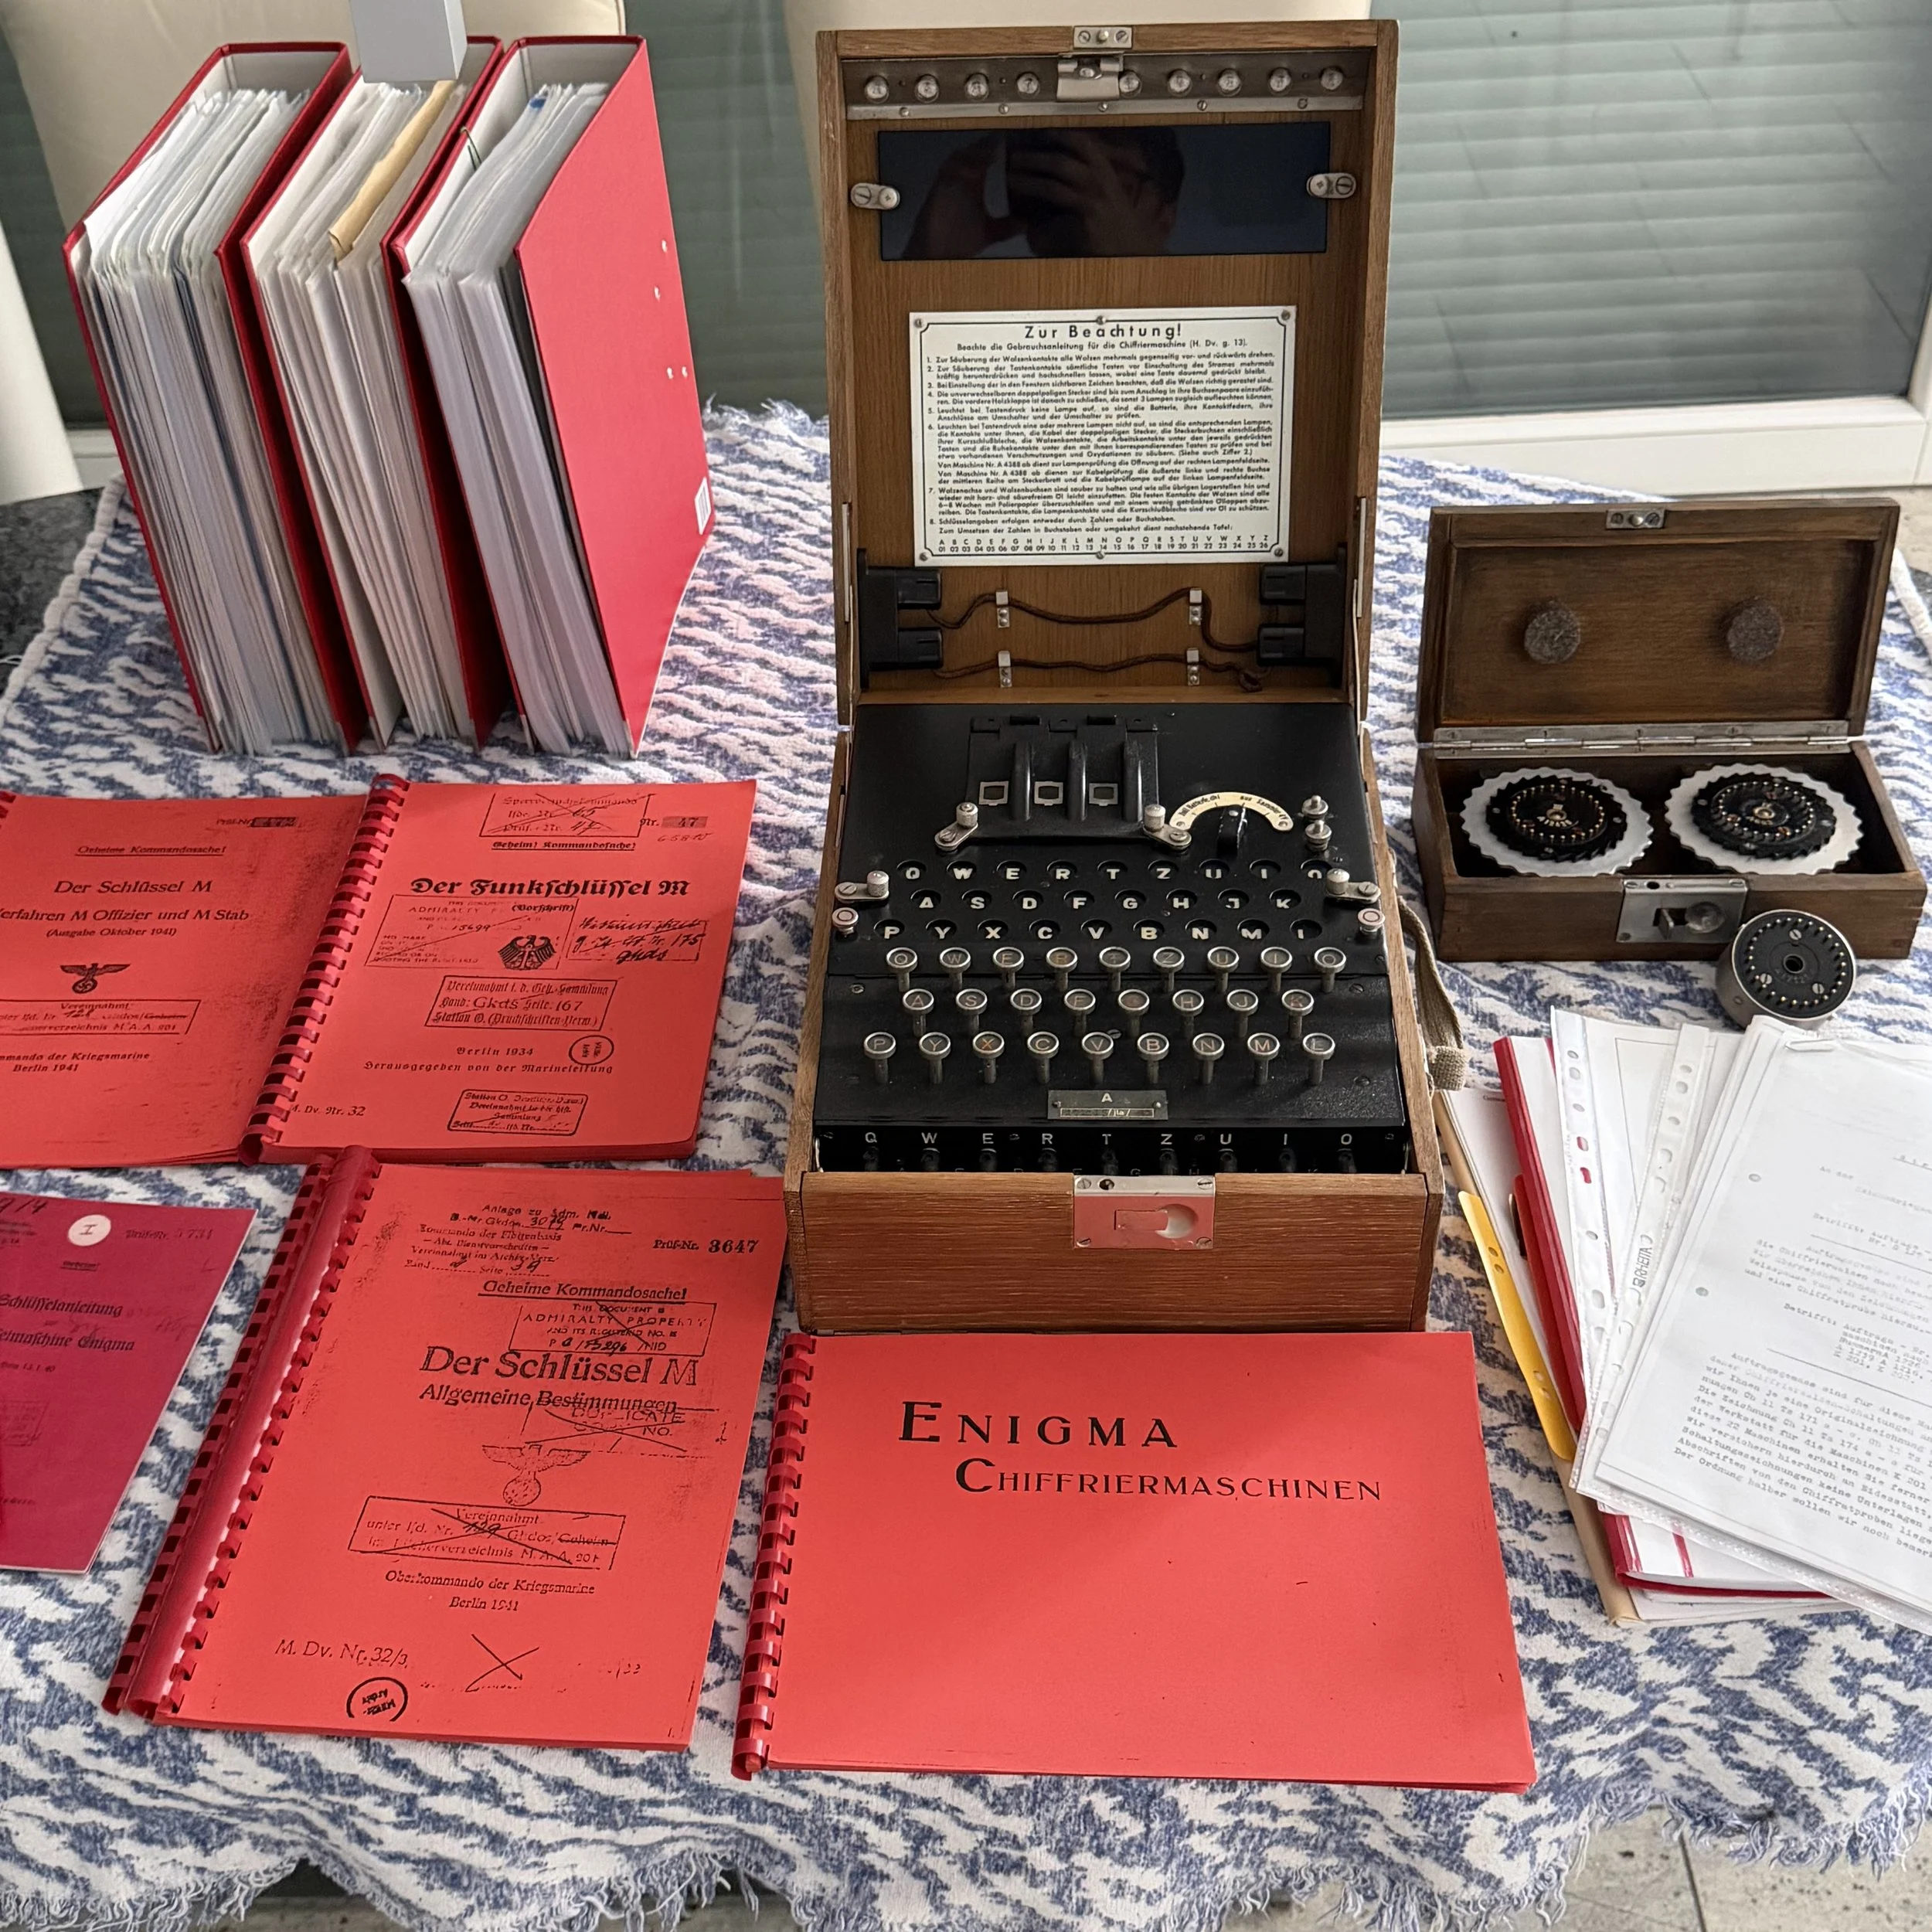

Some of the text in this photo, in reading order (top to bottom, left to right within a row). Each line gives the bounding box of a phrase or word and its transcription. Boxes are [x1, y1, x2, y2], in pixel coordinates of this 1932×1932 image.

[1025, 323, 1181, 340] Zur Beachtung!
[991, 342, 1003, 351] die
[1007, 342, 1083, 352] Gebrauchsanleitung
[1088, 341, 1100, 350] für
[1103, 341, 1115, 349] die
[1120, 340, 1185, 349] Chiffriermaschine
[939, 517, 998, 526] Schlüsselangaben
[1002, 517, 1029, 526] erfolgen
[1090, 515, 1114, 524] Zahlen
[1085, 524, 1100, 532] oder
[1104, 525, 1141, 533] umgekehrt
[1164, 523, 1210, 532] nachstehende
[906, 868, 1267, 879] Q W E R T Z U I
[54, 880, 213, 893] Der Schlüssel M
[410, 877, 463, 894] Der
[658, 880, 690, 896] M
[920, 897, 1290, 909] A S D F G H J K
[70, 910, 88, 920] M
[93, 910, 152, 920] Offizier
[157, 910, 189, 920] und
[193, 910, 210, 920] M
[214, 910, 250, 920] Stab
[100, 927, 147, 936] Oktober
[885, 927, 1261, 940] P Y X C V B N M
[556, 1001, 583, 1011] 167
[71, 1052, 151, 1062] Kriegsmarine
[457, 1047, 499, 1056] Berlin
[363, 1061, 461, 1072] Herausgegeben
[496, 1063, 517, 1072] der
[1102, 1094, 1112, 1102] A
[348, 1106, 366, 1116] 32
[866, 1132, 1352, 1145] Q W E R T Z U I O
[708, 1240, 759, 1253] 3647
[483, 1280, 687, 1300] Geheime Kommandosache!
[523, 1313, 614, 1326] ADMIRALTY
[419, 1346, 699, 1386] Der Schlüssel M
[419, 1384, 677, 1413] Allgemeine Bestimmungen
[385, 1570, 595, 1594] Oberkommando der Kriegsmarine
[448, 1597, 487, 1610] Berlin
[275, 1639, 296, 1655] M.
[303, 1641, 332, 1657] Dv.
